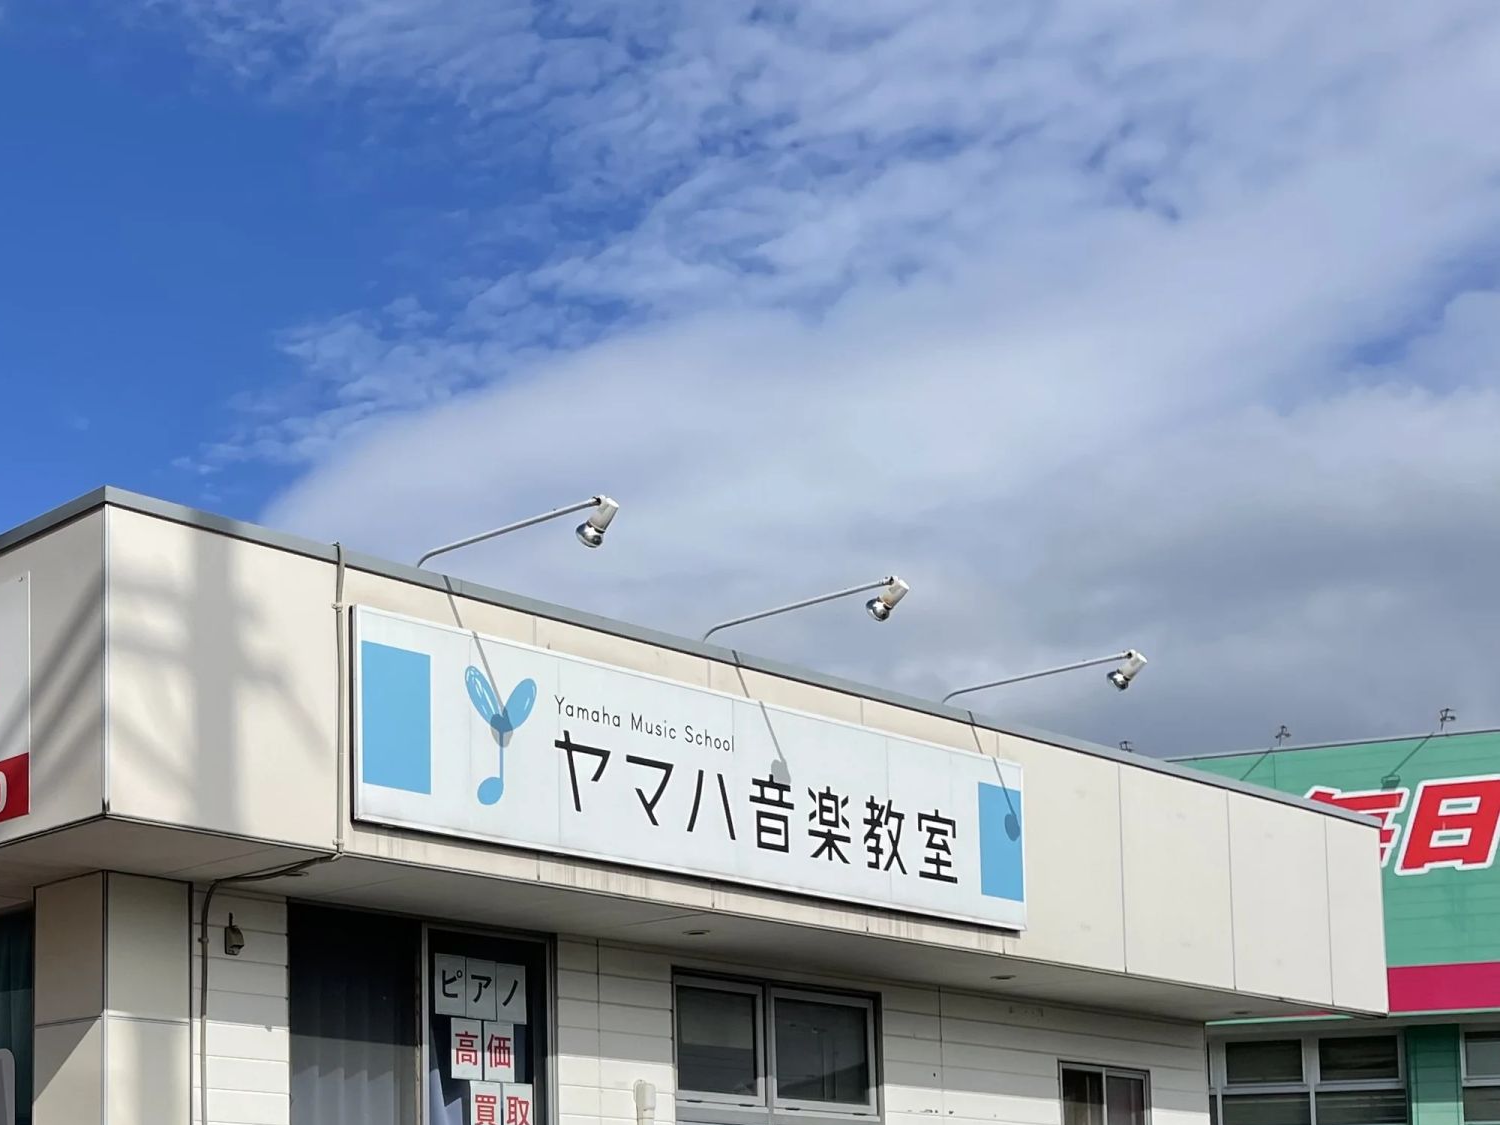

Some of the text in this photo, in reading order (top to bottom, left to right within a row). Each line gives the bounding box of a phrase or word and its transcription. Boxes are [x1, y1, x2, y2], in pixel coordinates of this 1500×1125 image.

[554, 694, 735, 753] Yamaha Music School
[554, 730, 959, 884] ヤマハ音楽教室
[441, 969, 518, 1007] ピアノ
[454, 1030, 512, 1069] 高価
